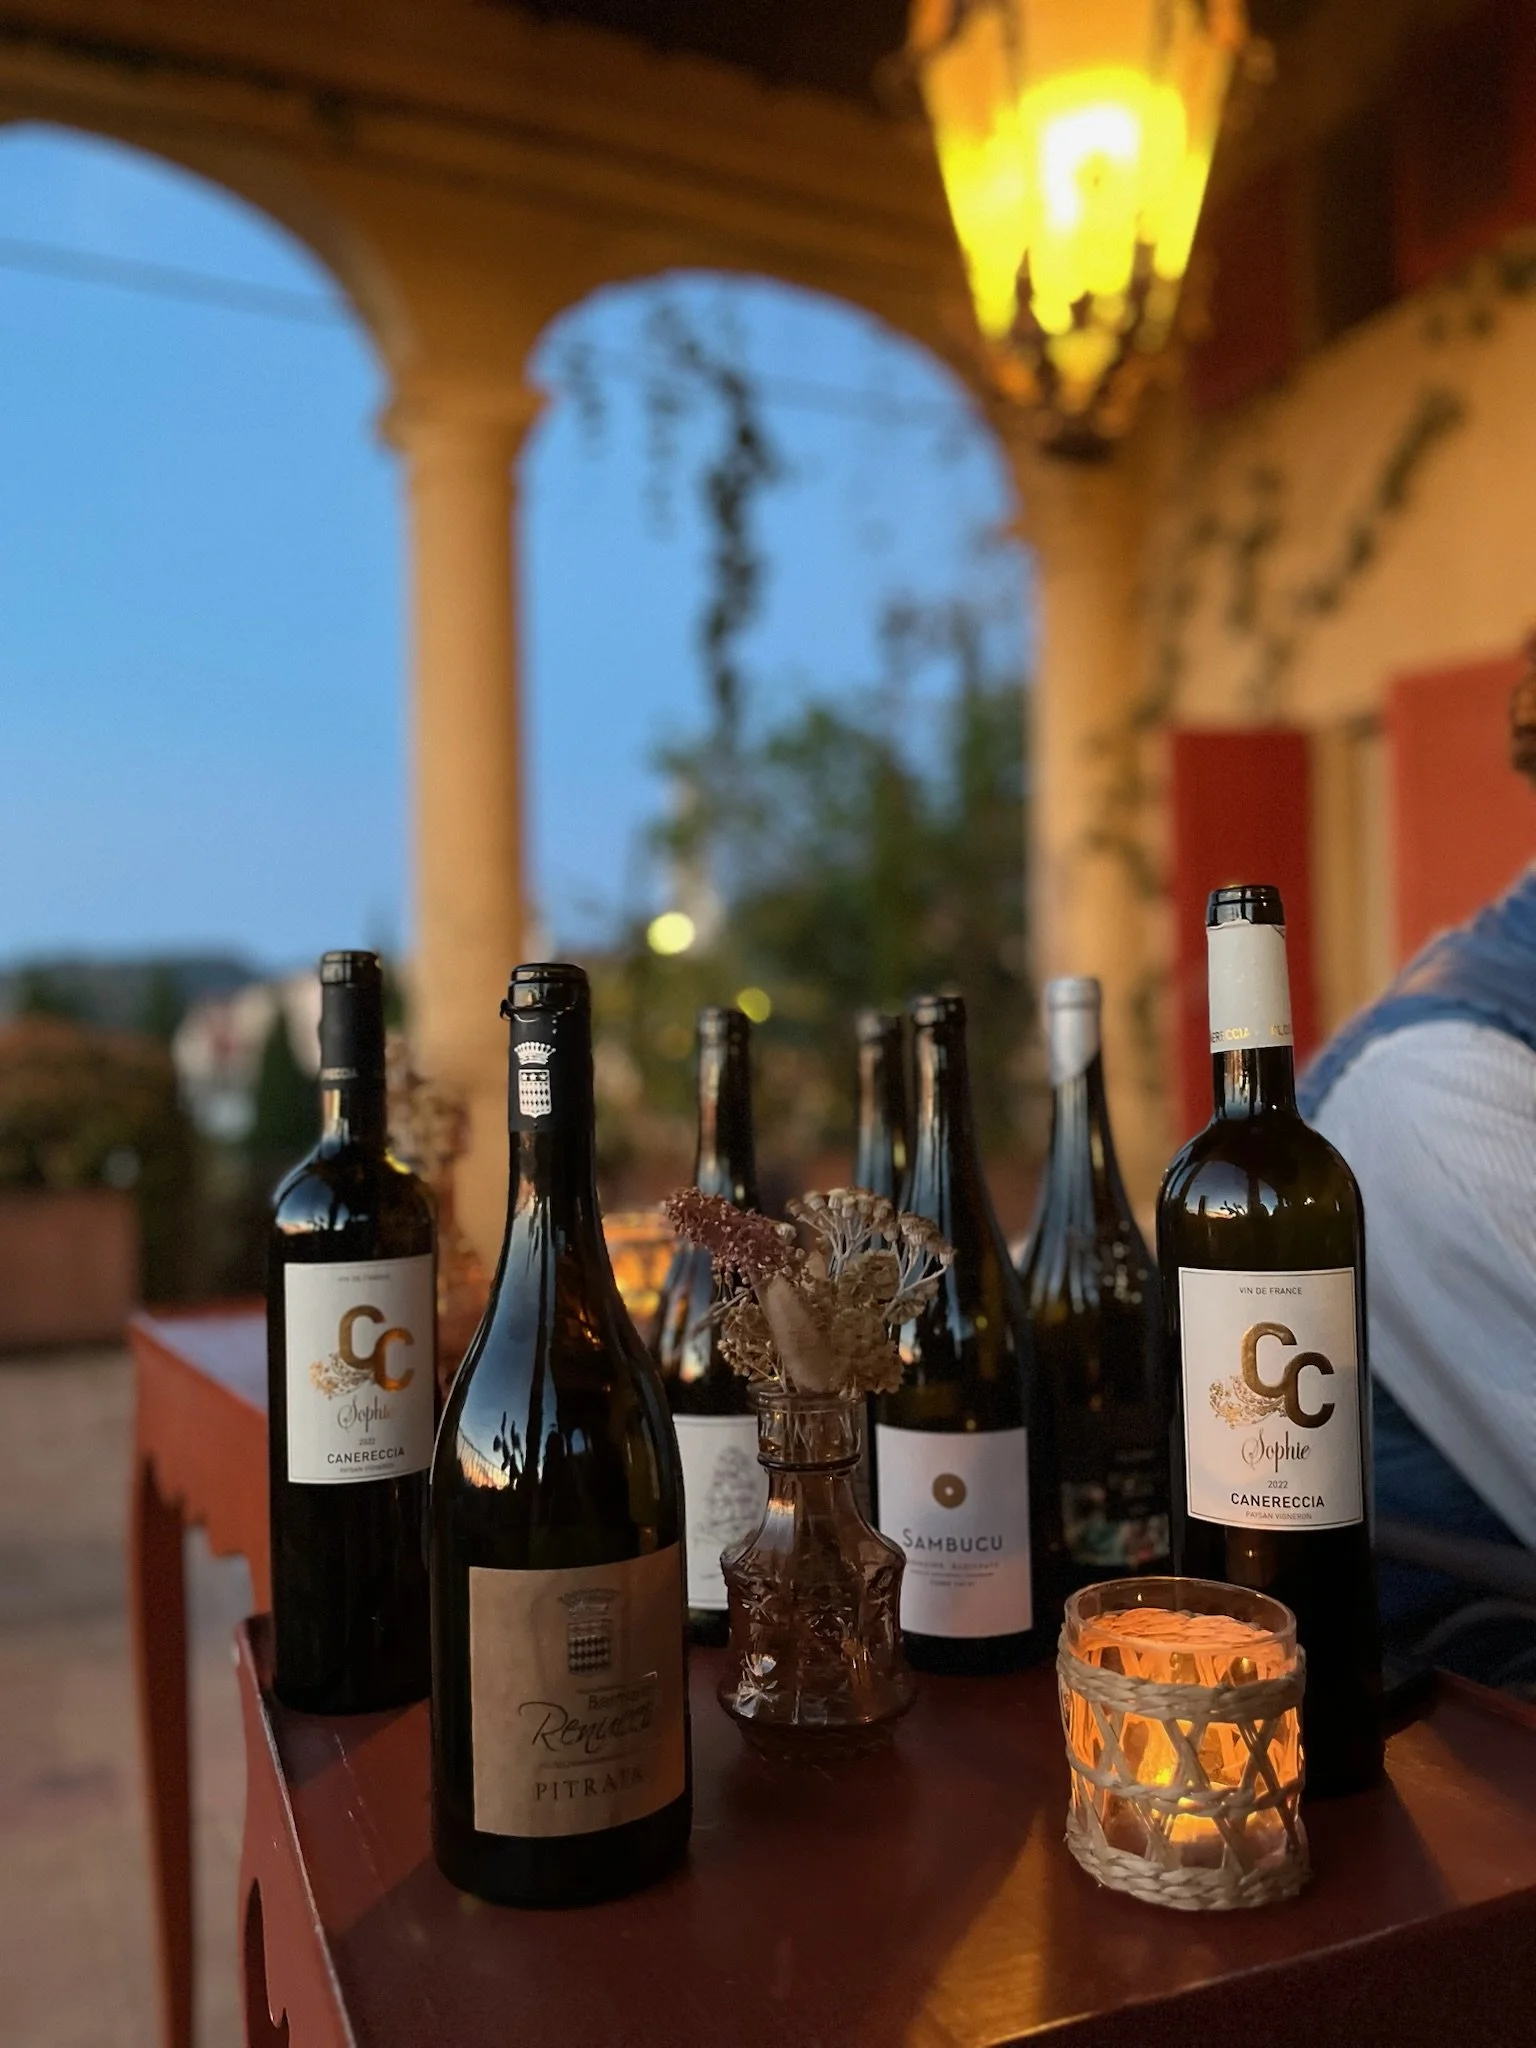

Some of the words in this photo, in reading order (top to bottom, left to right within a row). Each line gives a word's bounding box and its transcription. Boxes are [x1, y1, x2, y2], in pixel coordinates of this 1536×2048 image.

[1239, 1287, 1253, 1295] VIN
[1256, 1287, 1267, 1295] DE
[1269, 1287, 1303, 1295] FRANCE
[326, 1446, 405, 1465] CANERECCIA
[1241, 1428, 1311, 1473] Sophie
[1267, 1480, 1289, 1489] 2022
[1230, 1492, 1326, 1508] CANERECCIA
[1245, 1510, 1274, 1519] PAYSAN
[1275, 1511, 1312, 1519] VIGNERON
[902, 1527, 1004, 1553] SAMBUCU
